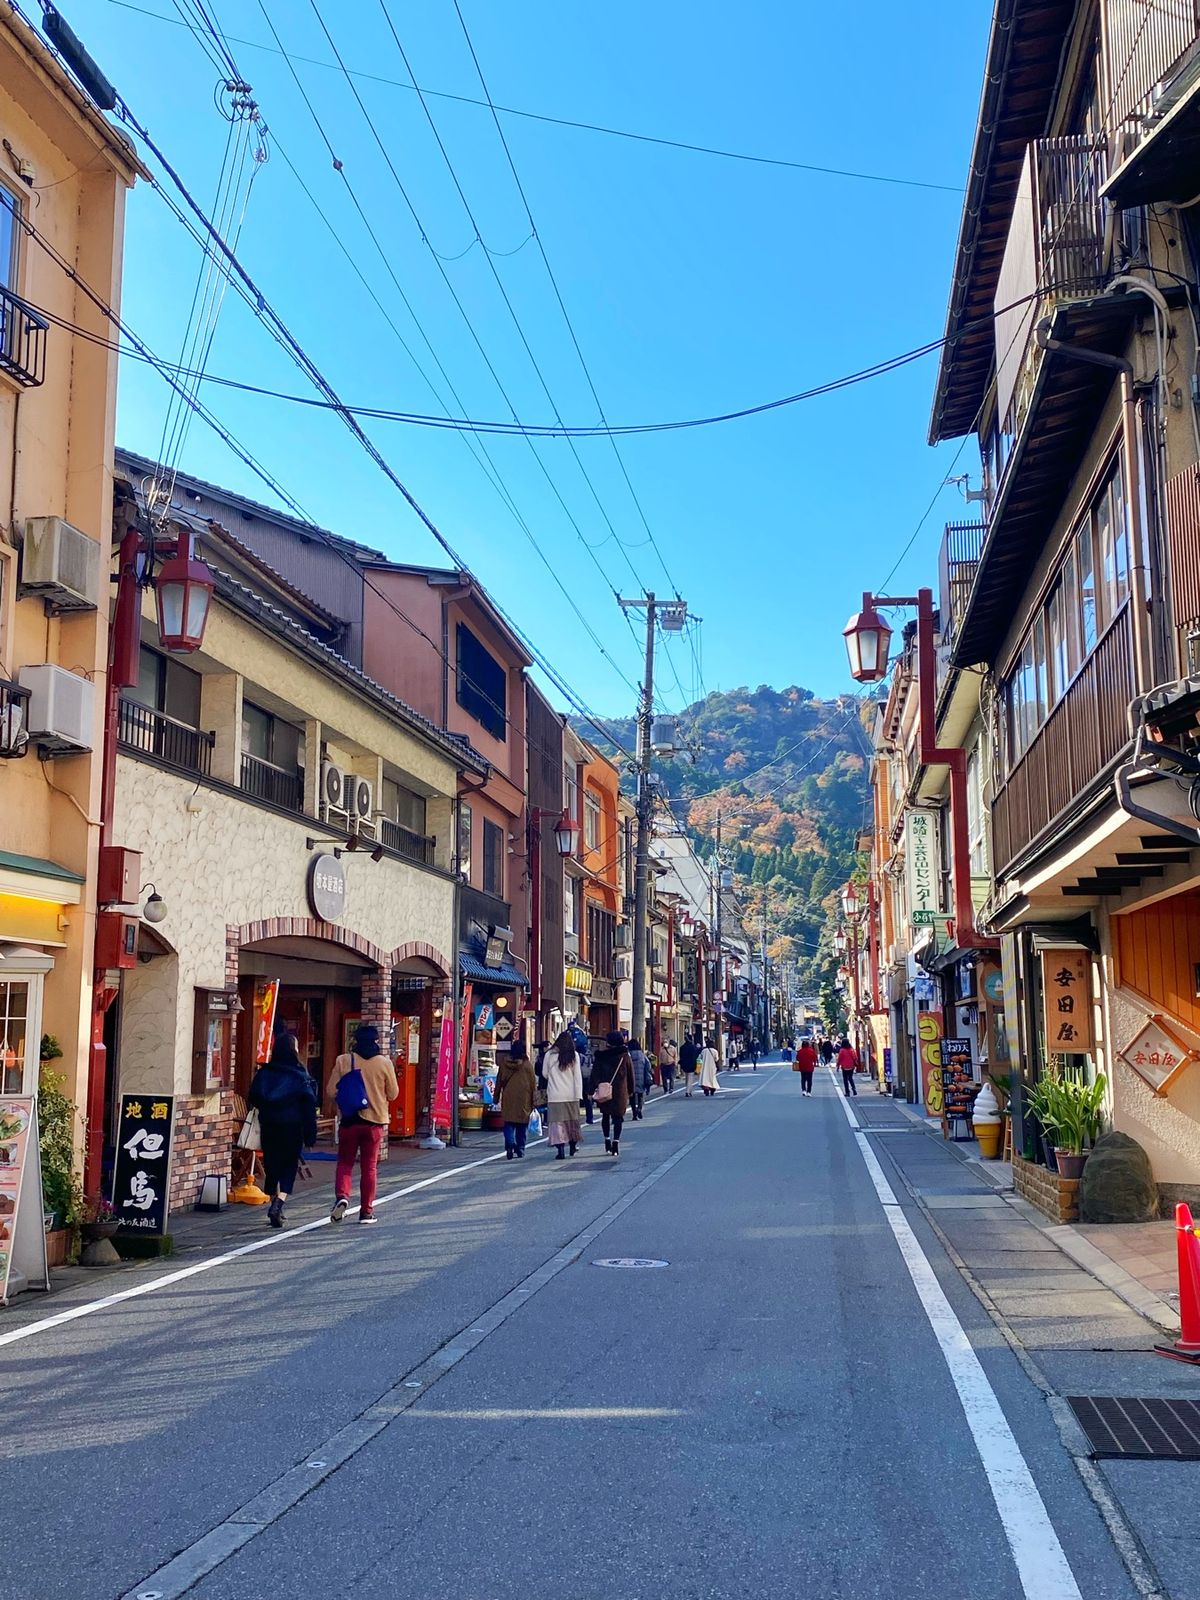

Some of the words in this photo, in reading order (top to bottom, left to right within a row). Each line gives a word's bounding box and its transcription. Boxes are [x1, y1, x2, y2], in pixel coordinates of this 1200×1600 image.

[1054, 967, 1078, 1042] 安田屋
[947, 1044, 969, 1052] ねり天
[1133, 1050, 1177, 1066] 安田屋
[125, 1101, 169, 1120] 地酒
[122, 1128, 164, 1211] 但馬
